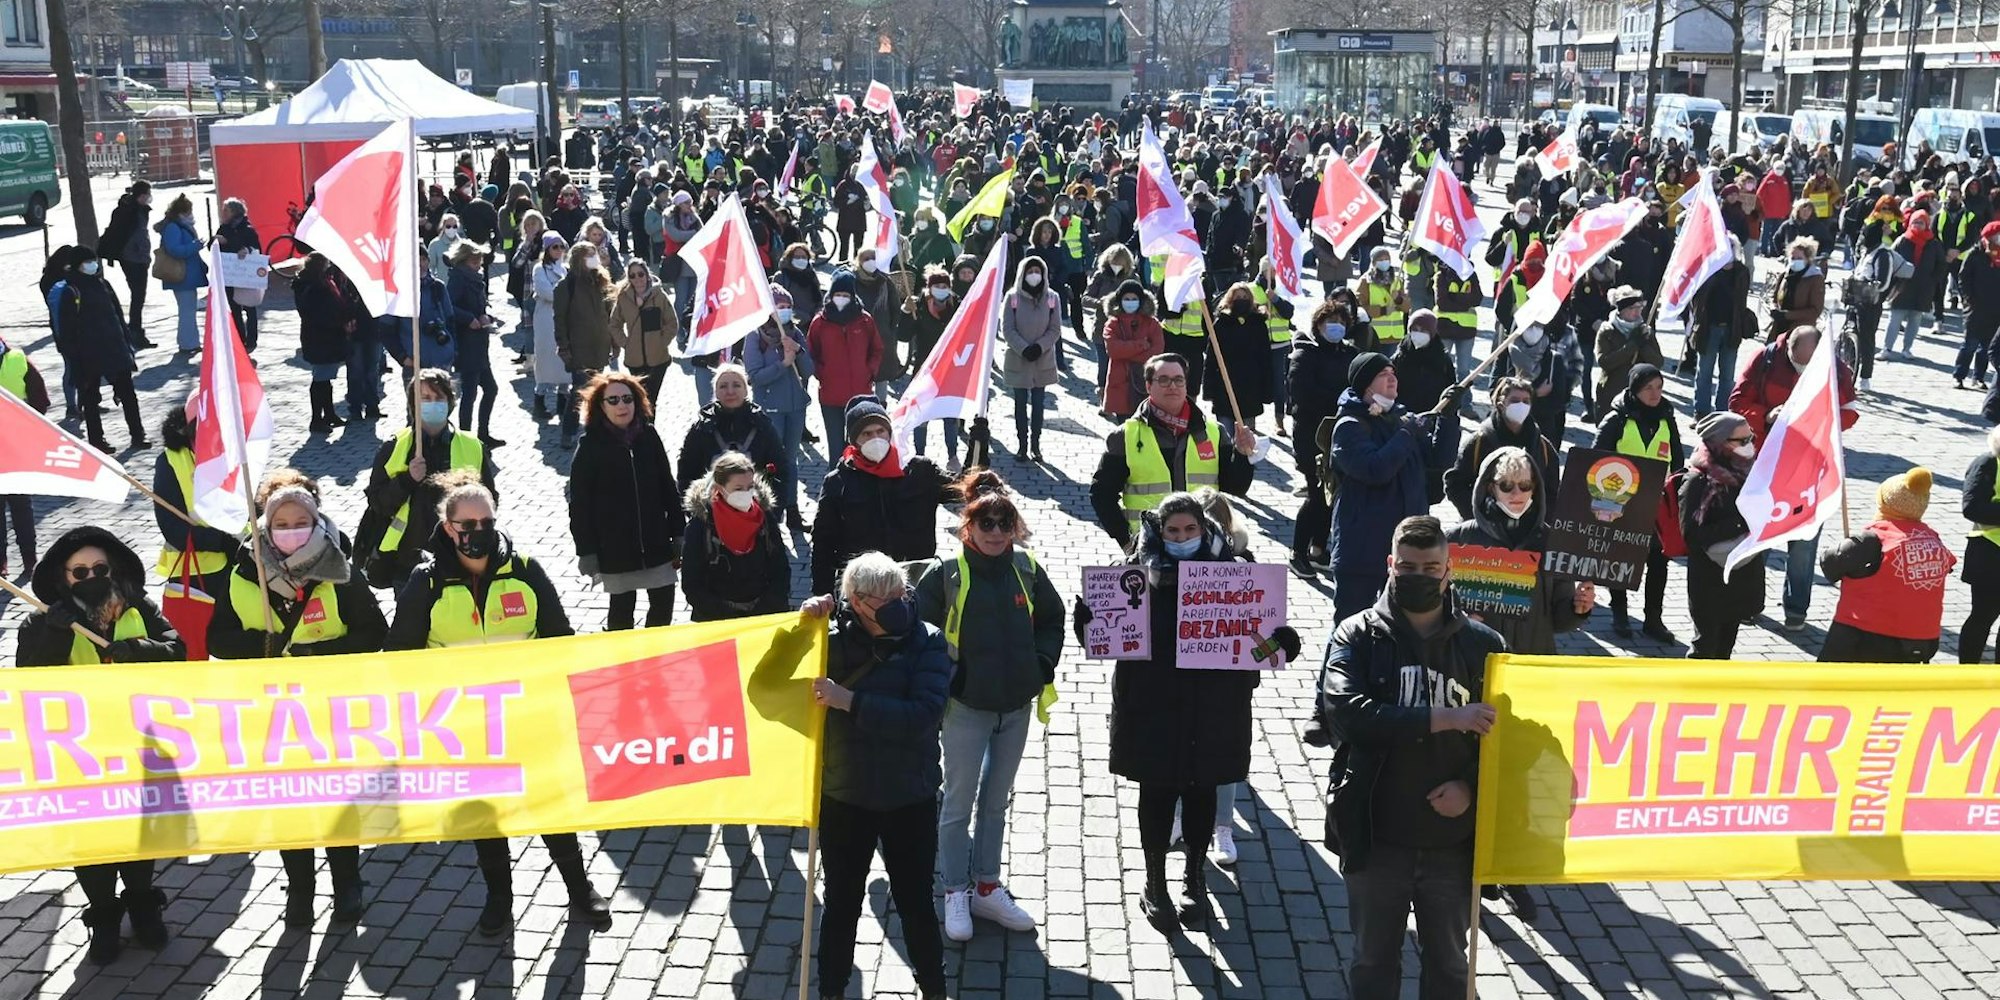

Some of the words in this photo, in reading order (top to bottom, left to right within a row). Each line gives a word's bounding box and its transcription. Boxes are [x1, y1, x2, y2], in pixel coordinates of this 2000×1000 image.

[1554, 518, 1574, 532] DIE
[1578, 522, 1610, 538] WELT
[1612, 529, 1653, 548] BRAUCHT
[1587, 538, 1611, 554] DEN
[1188, 567, 1209, 578] WIR
[1544, 550, 1635, 584] FEMINISM
[1183, 580, 1229, 591] GARNICHT
[1239, 579, 1254, 592] SO
[1181, 589, 1265, 606] SCHLECHT
[1477, 587, 1503, 600] sind
[1182, 607, 1232, 619] ARBEITEN
[1237, 607, 1253, 618] WIE
[1258, 607, 1277, 618] WIR
[1089, 627, 1105, 637] YES
[1122, 623, 1136, 633] NO
[1179, 618, 1262, 639] BEZAHLT
[1090, 643, 1110, 656] YES
[1122, 641, 1140, 653] NO
[1179, 642, 1228, 654] WERDEN
[592, 726, 734, 766] ver.di
[1573, 700, 1852, 800] MEHR
[1848, 706, 1912, 835] BRAUCHT
[1906, 707, 2000, 797] M
[103, 782, 161, 811] UND
[174, 770, 470, 803] ERZIEHUNGSBERUFE
[1615, 804, 1790, 829] ENTLASTUNG
